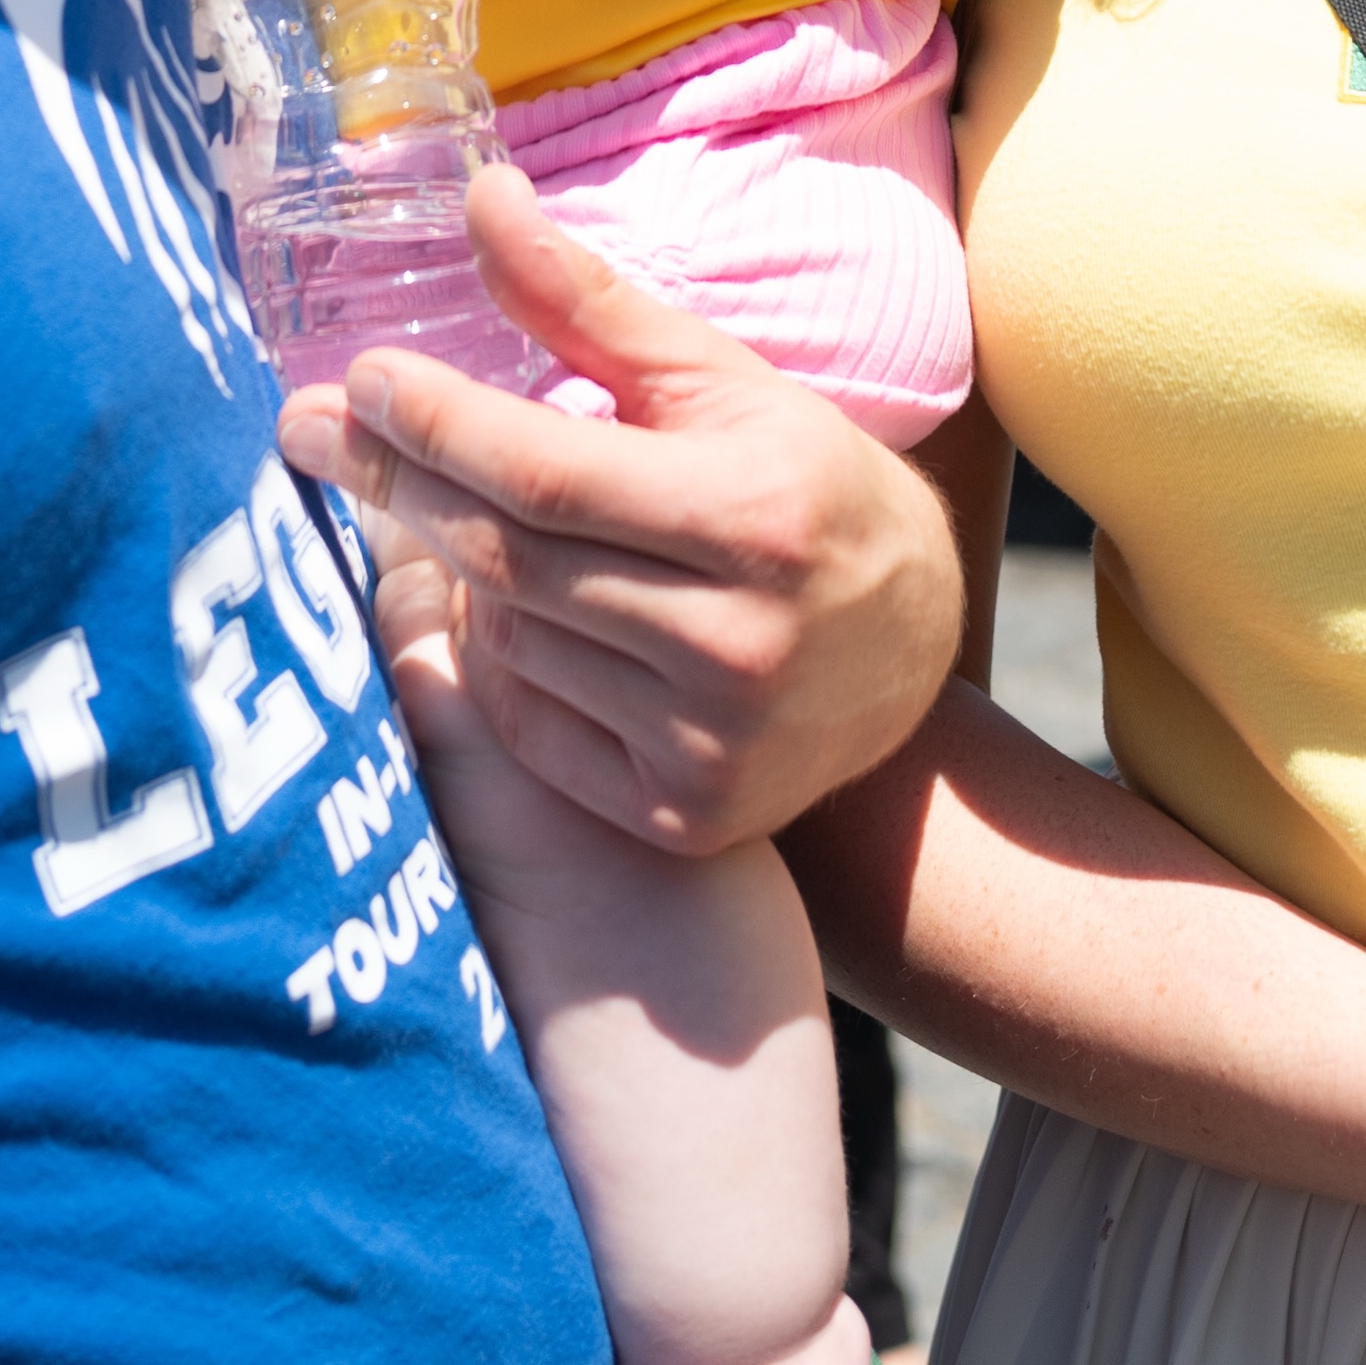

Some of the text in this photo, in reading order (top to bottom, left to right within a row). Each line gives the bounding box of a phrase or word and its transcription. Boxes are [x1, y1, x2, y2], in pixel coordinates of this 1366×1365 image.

[317, 699, 419, 877] IN-H
[286, 820, 458, 1036] TOUR
[460, 943, 506, 1053] 2
